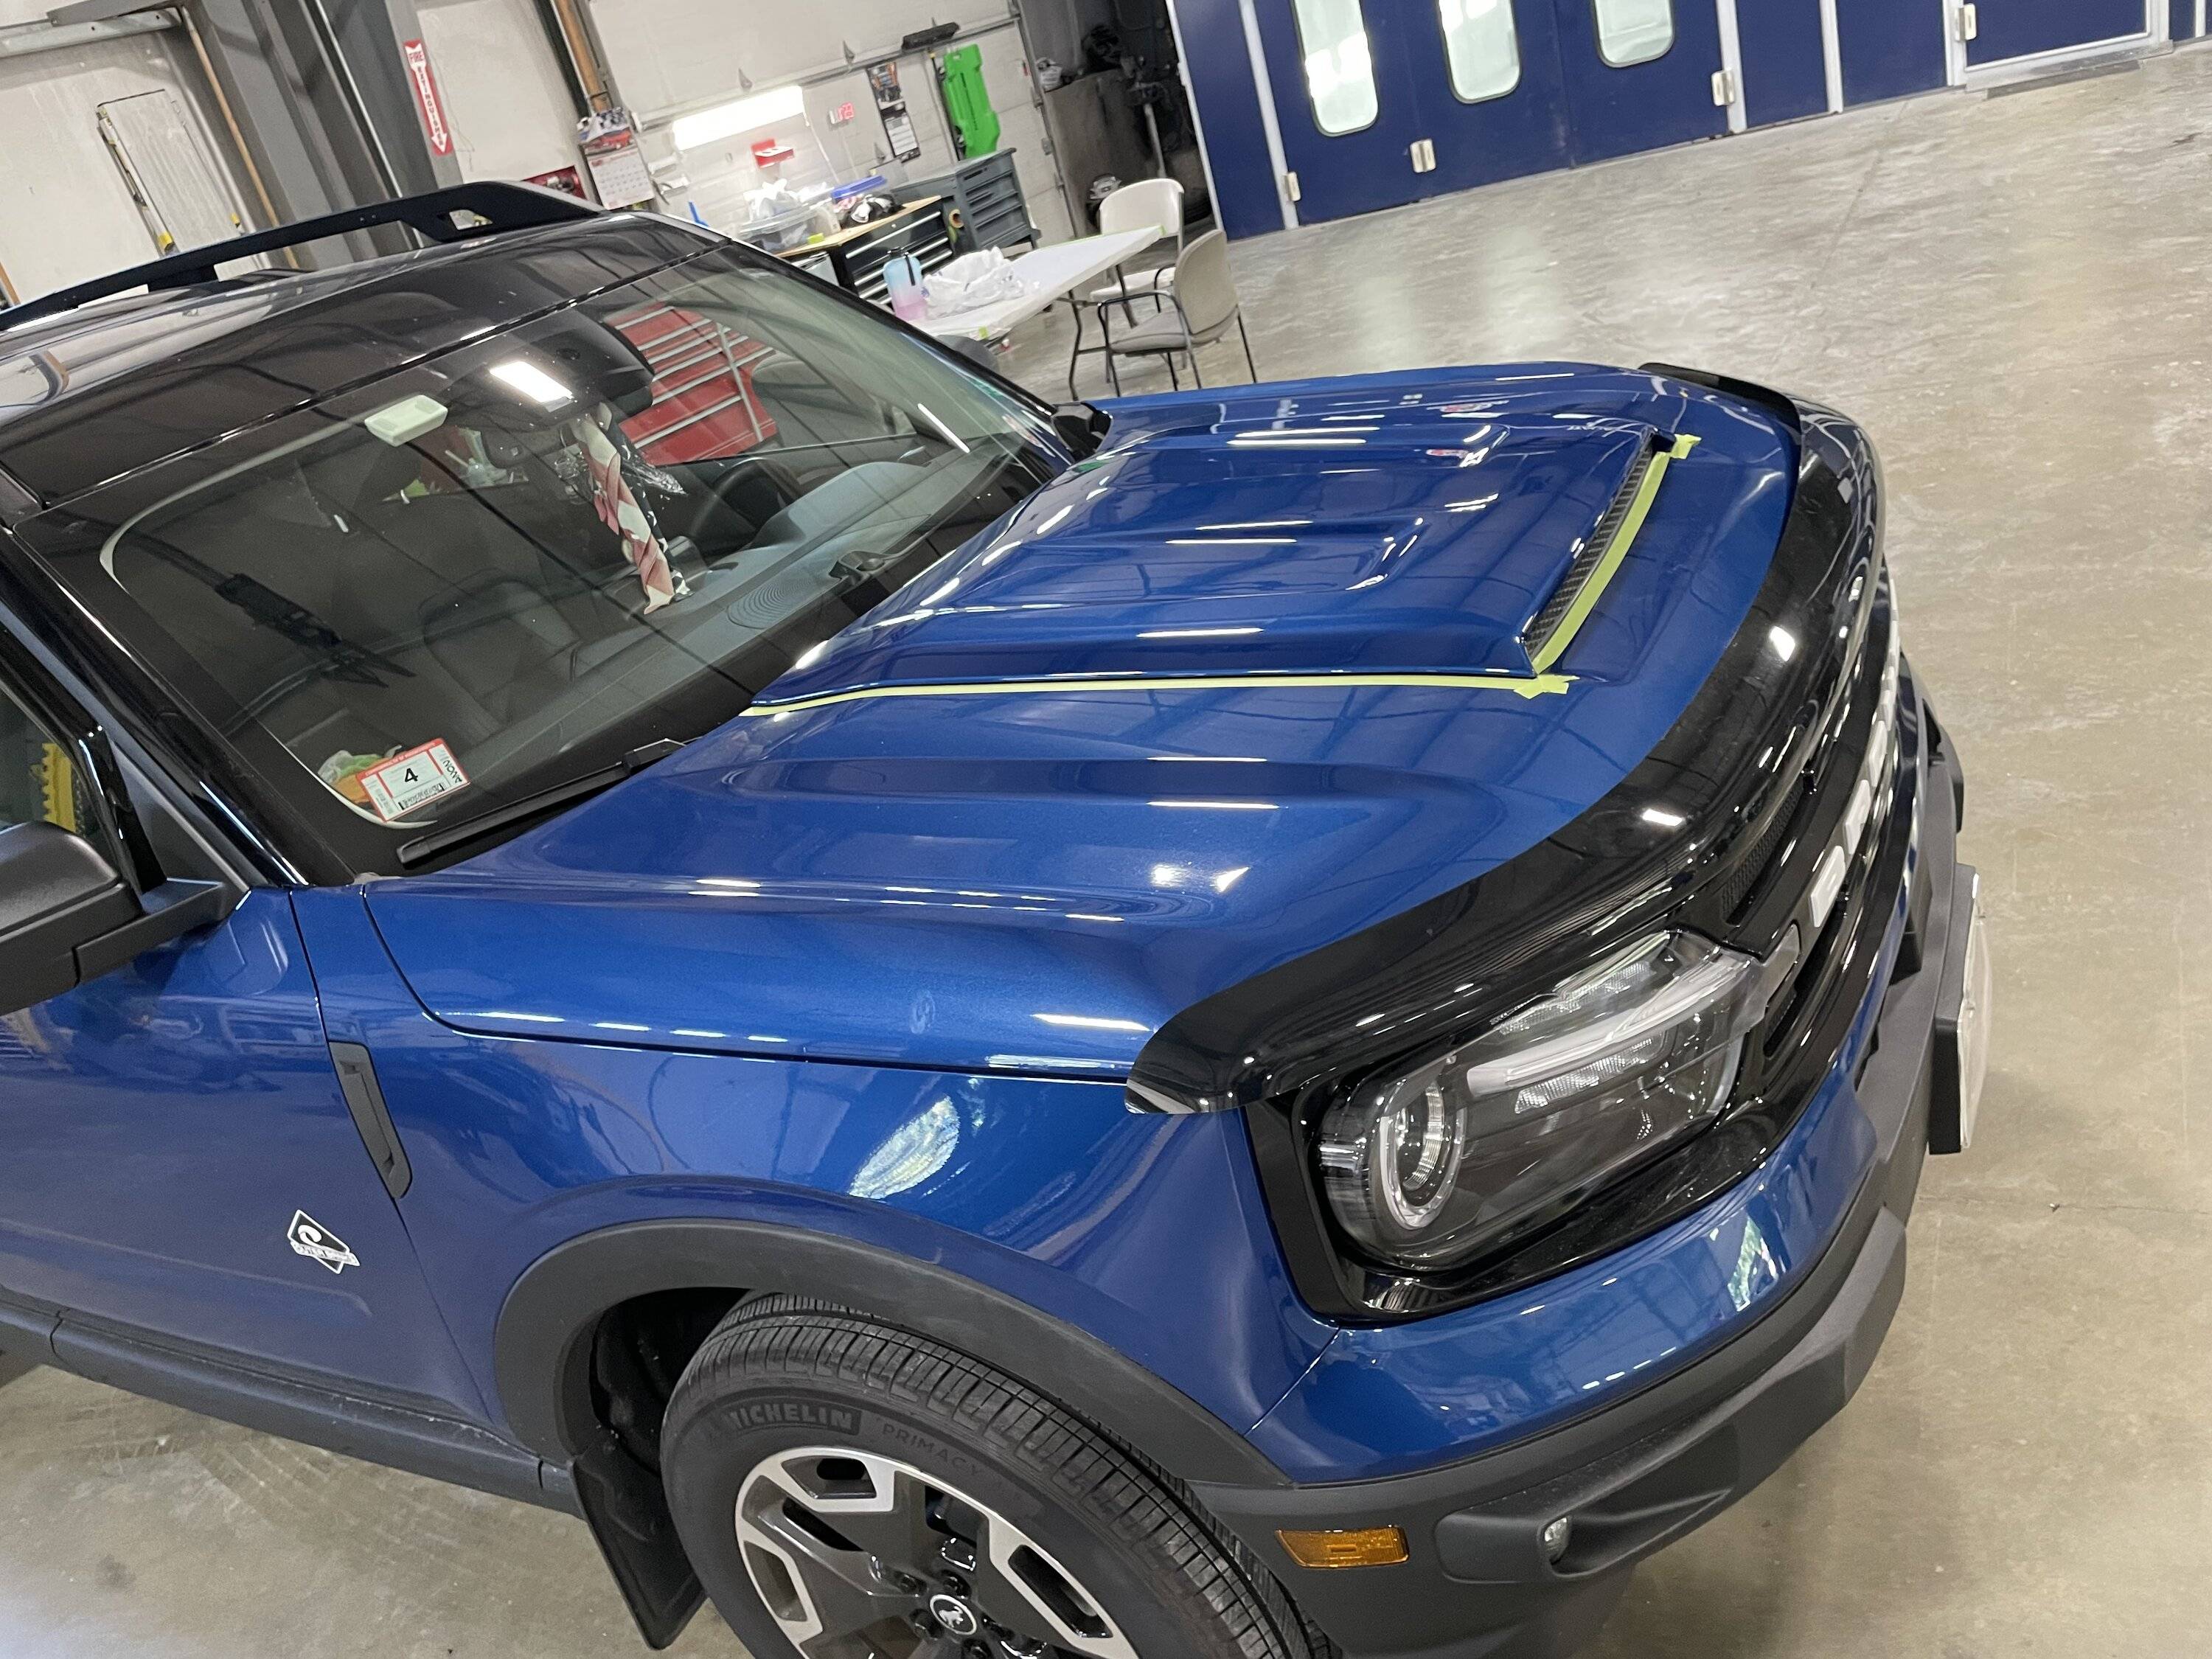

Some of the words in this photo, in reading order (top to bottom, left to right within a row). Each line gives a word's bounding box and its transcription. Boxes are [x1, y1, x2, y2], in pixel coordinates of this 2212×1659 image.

[408, 51, 425, 63] FIRE
[404, 768, 419, 783] 4
[881, 1423, 981, 1475] PRIMACY
